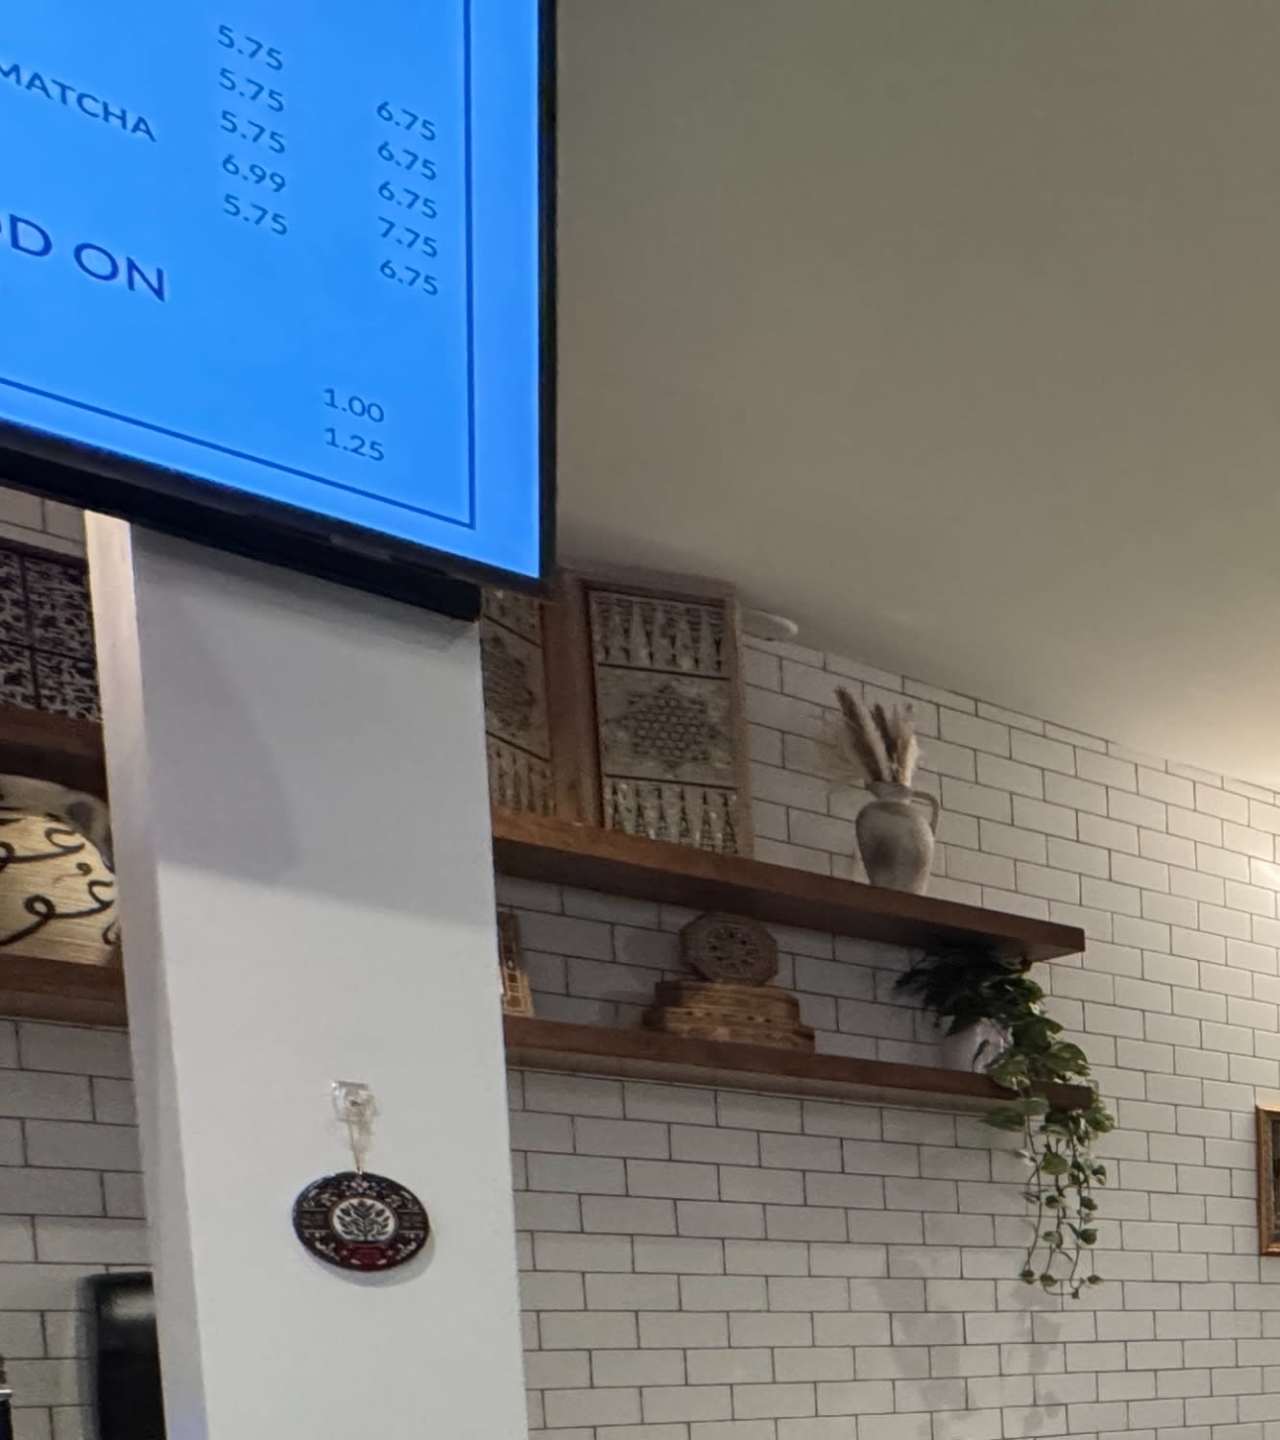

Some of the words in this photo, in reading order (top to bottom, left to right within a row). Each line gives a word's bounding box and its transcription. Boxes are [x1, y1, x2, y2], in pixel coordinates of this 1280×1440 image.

[217, 24, 284, 71] 5.75
[376, 101, 437, 142] 6.75
[218, 67, 285, 113] 5.75
[377, 141, 437, 181] 6.75
[219, 109, 286, 154] 5.75
[378, 181, 438, 220] 6.75
[222, 154, 287, 193] 6.99
[378, 216, 438, 259] 7.75
[73, 242, 165, 301] ON
[223, 193, 288, 236] 5.75
[379, 259, 439, 296] 6.75
[323, 388, 385, 423] 1.00
[324, 427, 385, 461] 1.25
